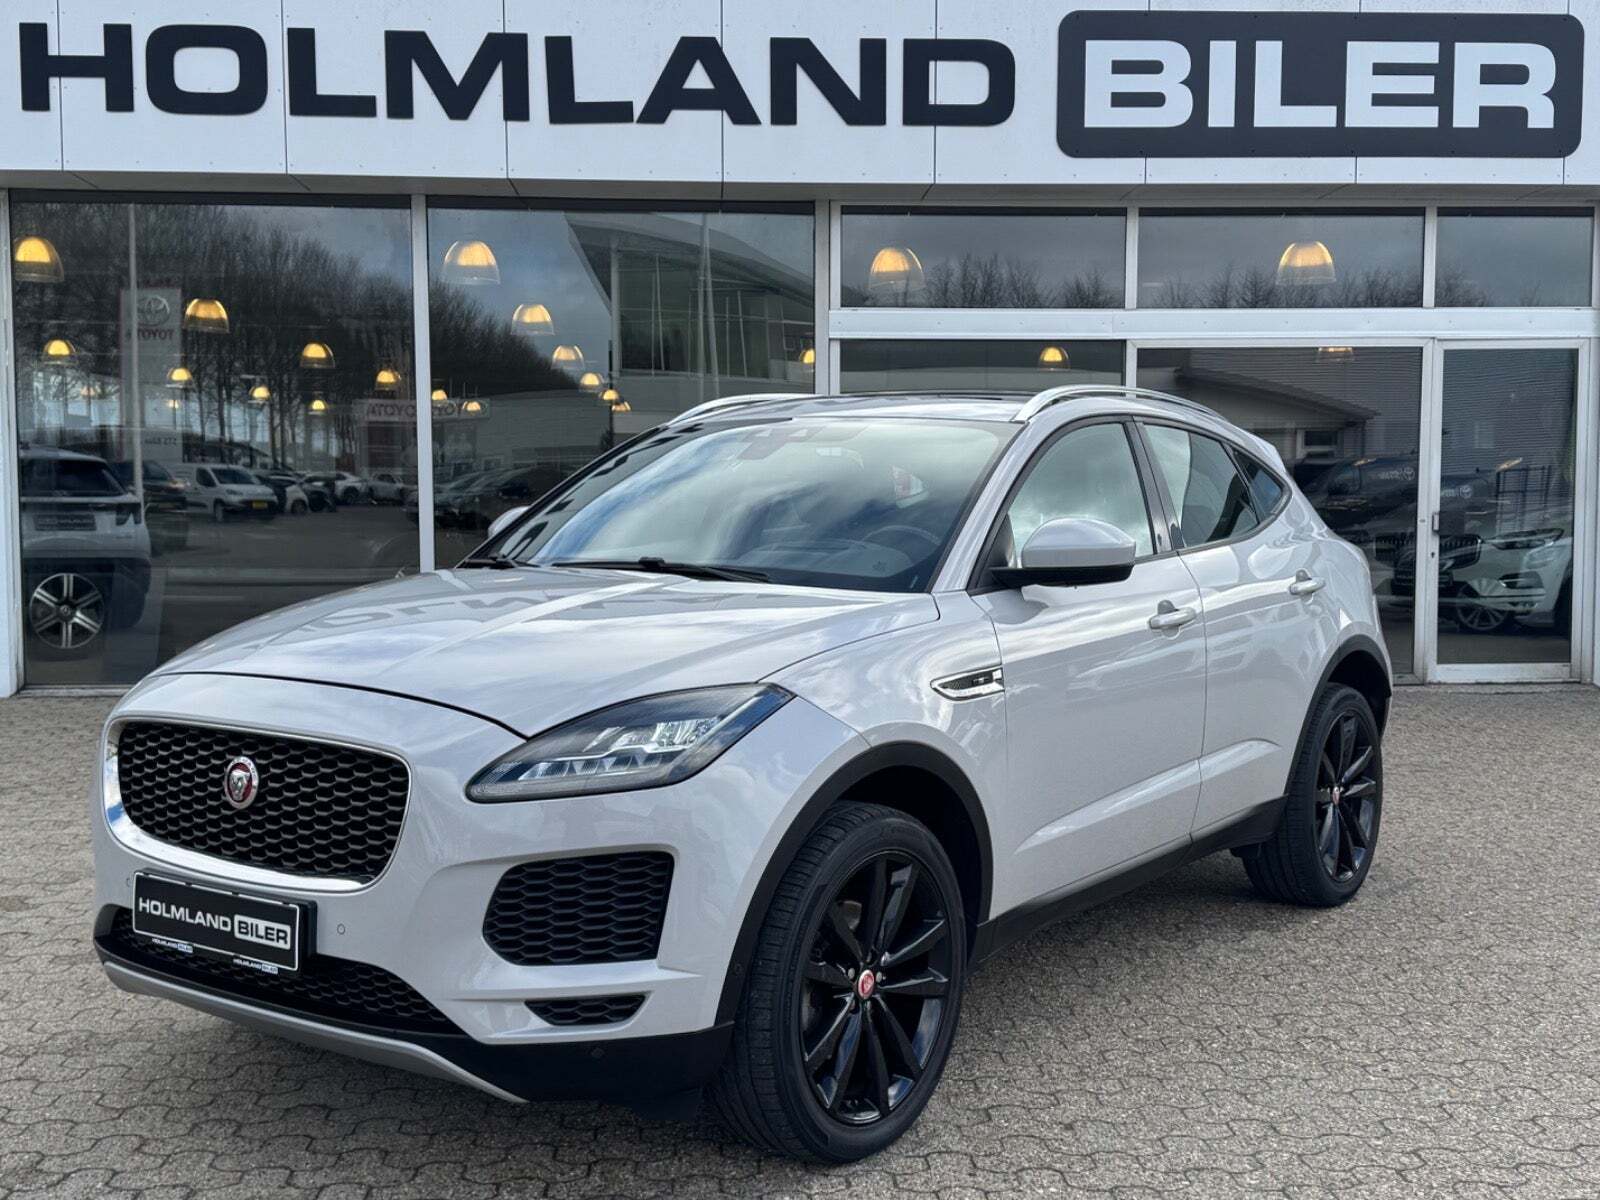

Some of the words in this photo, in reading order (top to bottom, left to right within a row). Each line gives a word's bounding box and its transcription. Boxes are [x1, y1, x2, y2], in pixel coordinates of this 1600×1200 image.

[20, 23, 1016, 126] HOLMLAND
[1083, 40, 1557, 129] BILER
[138, 897, 232, 932] HOLMLAND
[238, 920, 288, 944] BILER
